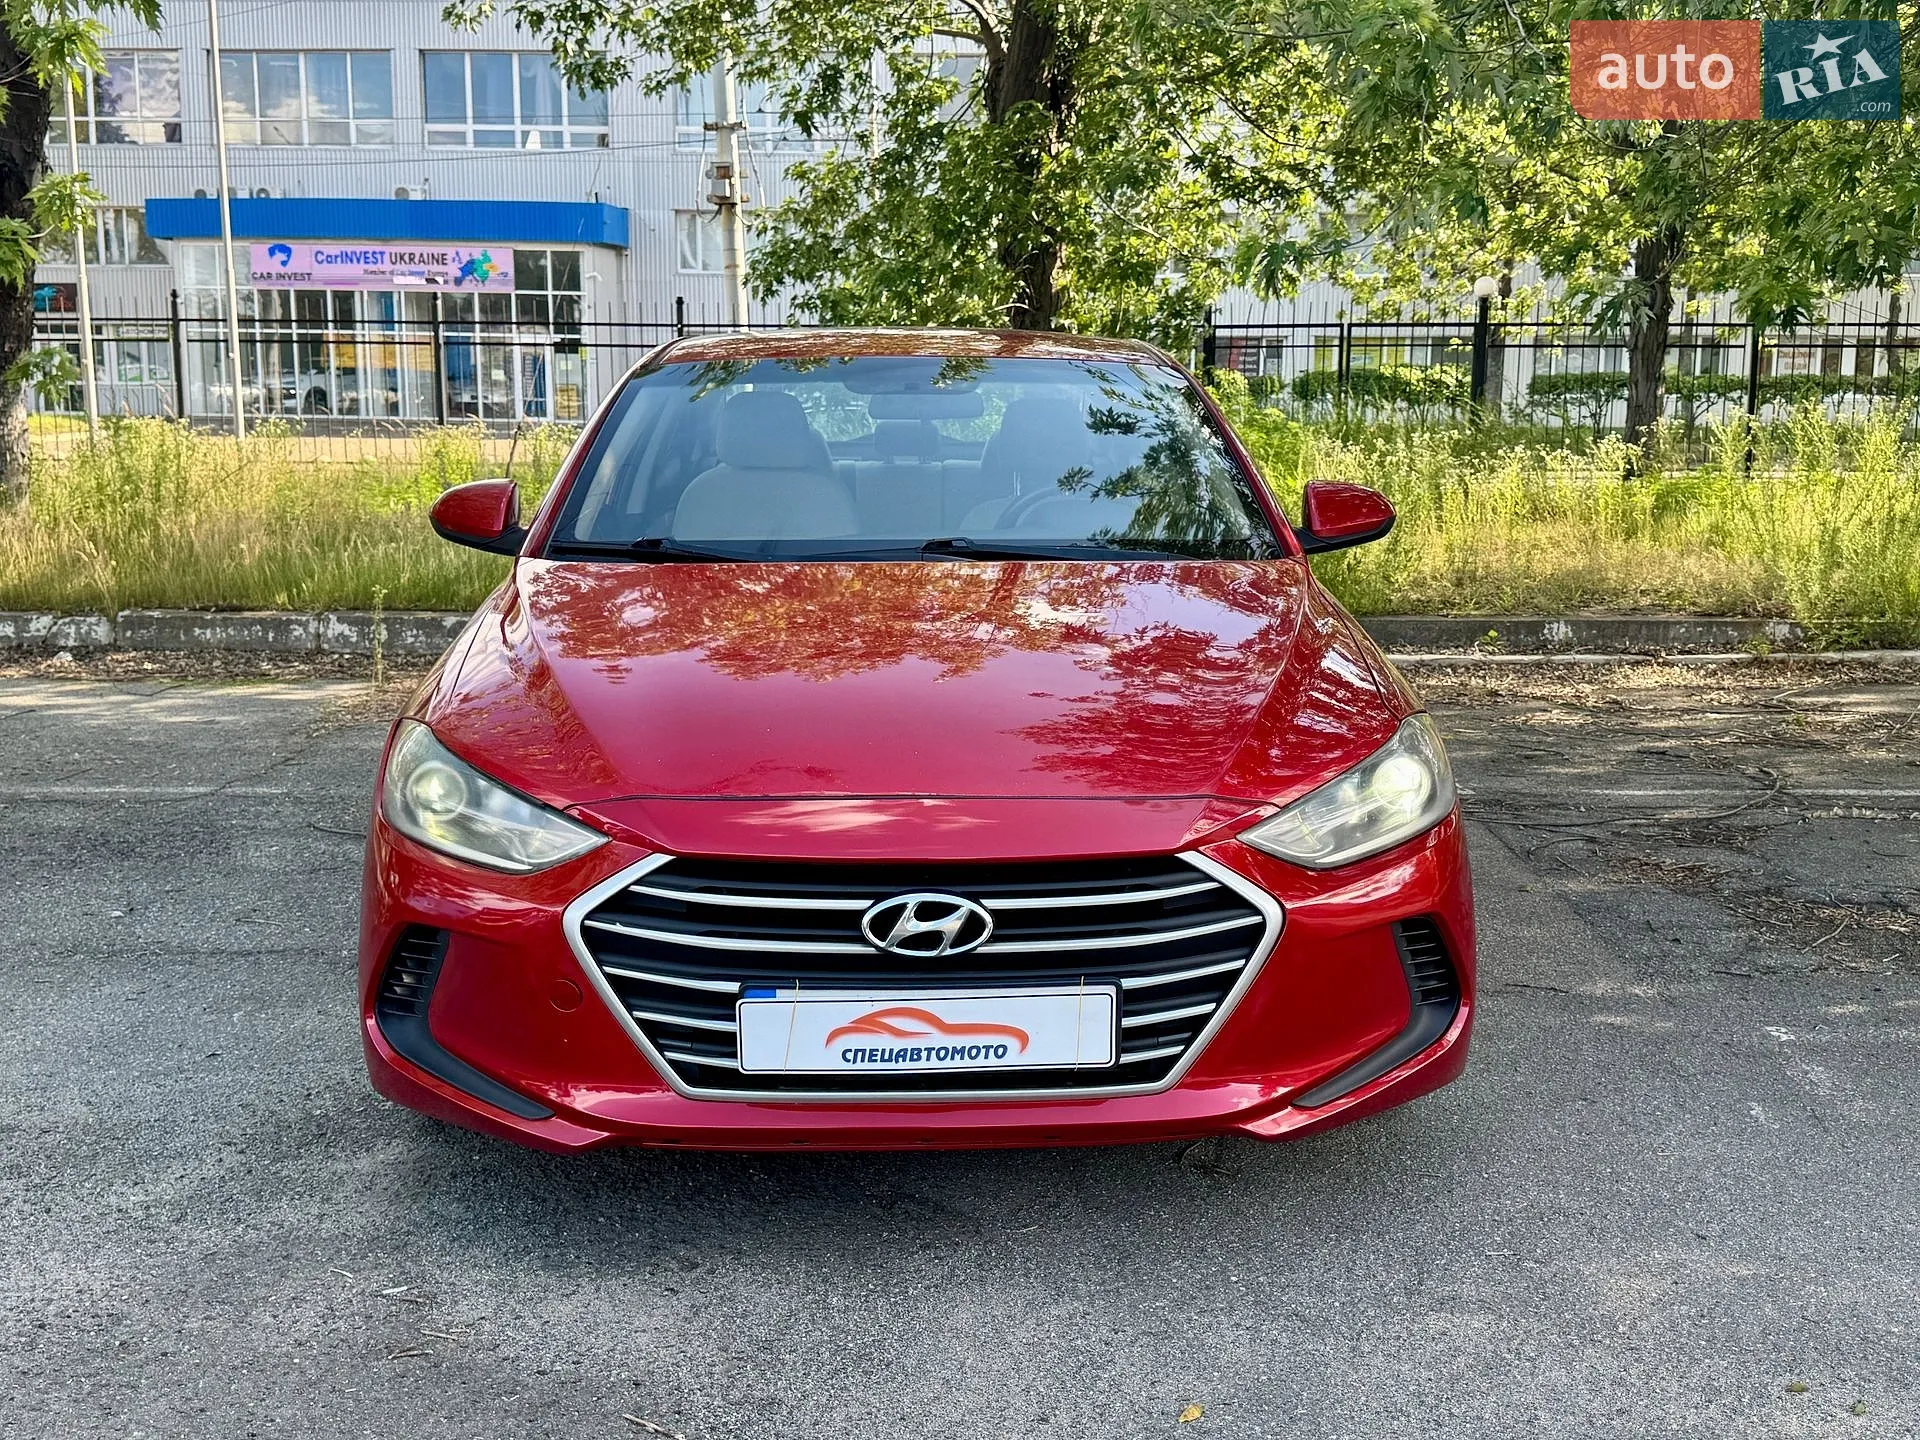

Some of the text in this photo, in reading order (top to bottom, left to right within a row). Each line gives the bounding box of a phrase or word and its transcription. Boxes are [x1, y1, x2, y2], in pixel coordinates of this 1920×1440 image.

[314, 250, 449, 266] CarINVEST UKRAINE
[251, 272, 312, 281] CAR INVEST
[841, 1044, 1008, 1065] СПЕЦАВТОМОТО
